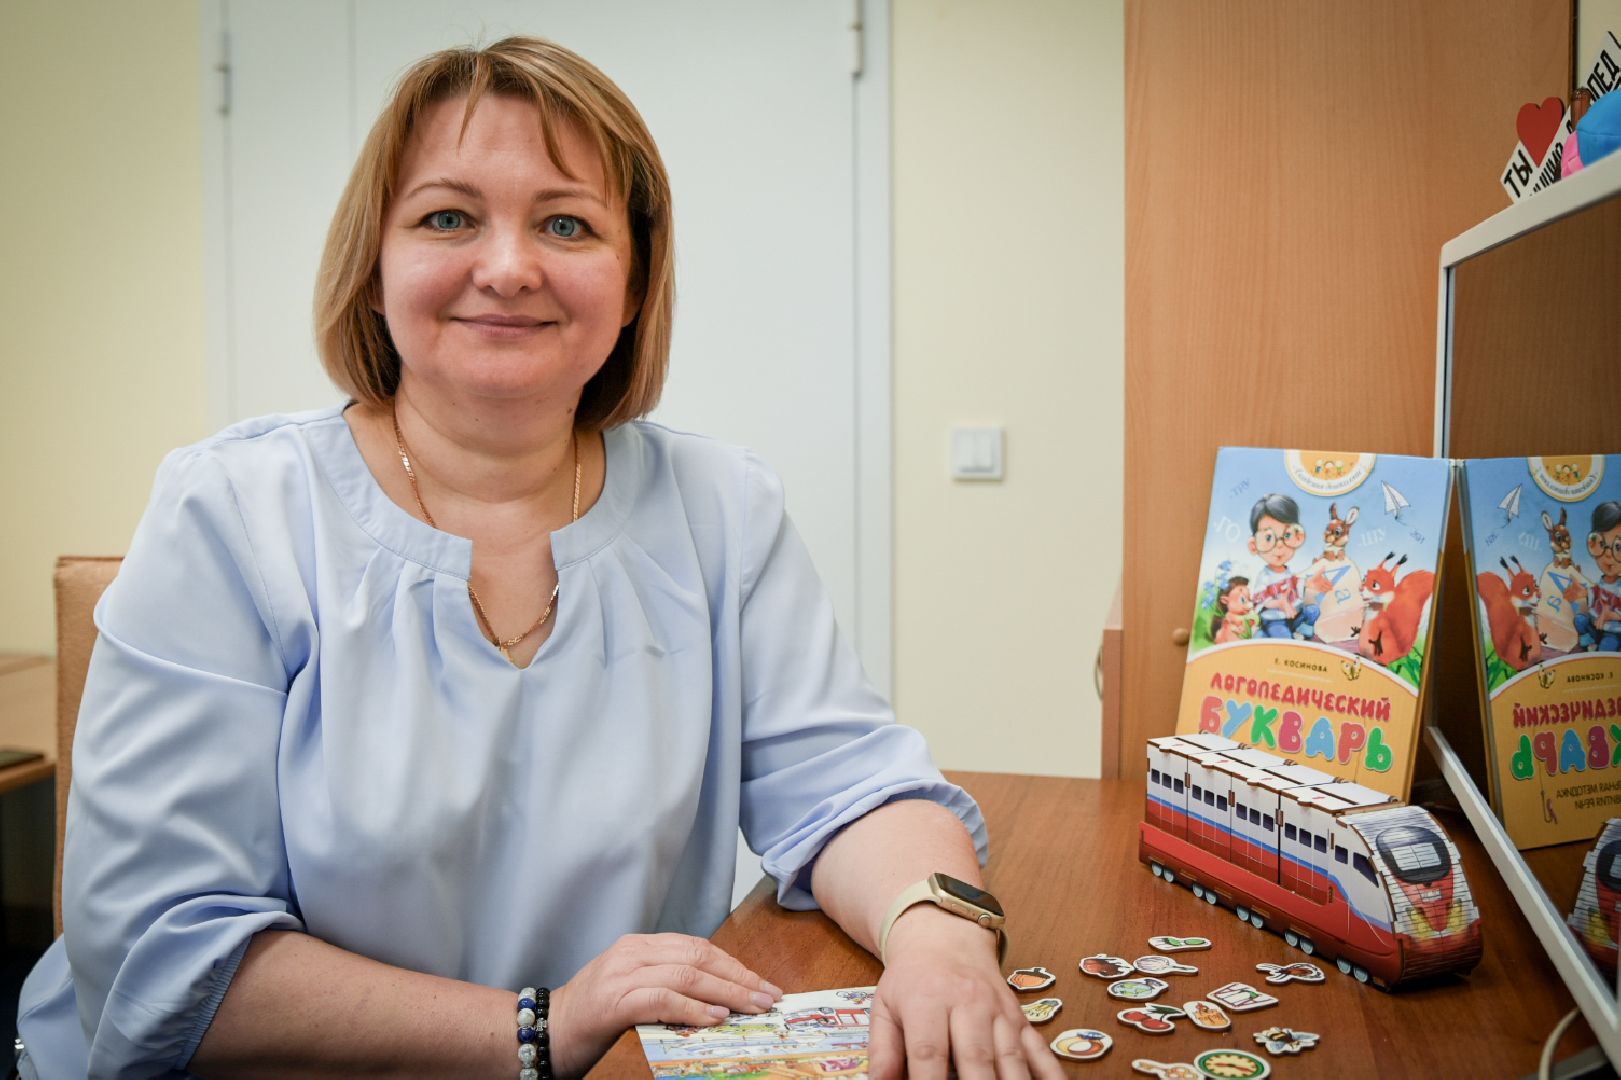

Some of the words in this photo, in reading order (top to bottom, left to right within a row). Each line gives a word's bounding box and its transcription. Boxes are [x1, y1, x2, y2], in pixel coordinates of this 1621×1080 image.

[1503, 149, 1533, 198] ТЫ
[1284, 659, 1328, 673] КОСИНОВА
[1210, 672, 1391, 722] ЛОГОПЕДИЧЕСКИЙ
[1200, 696, 1393, 772] БУКВАРЬ
